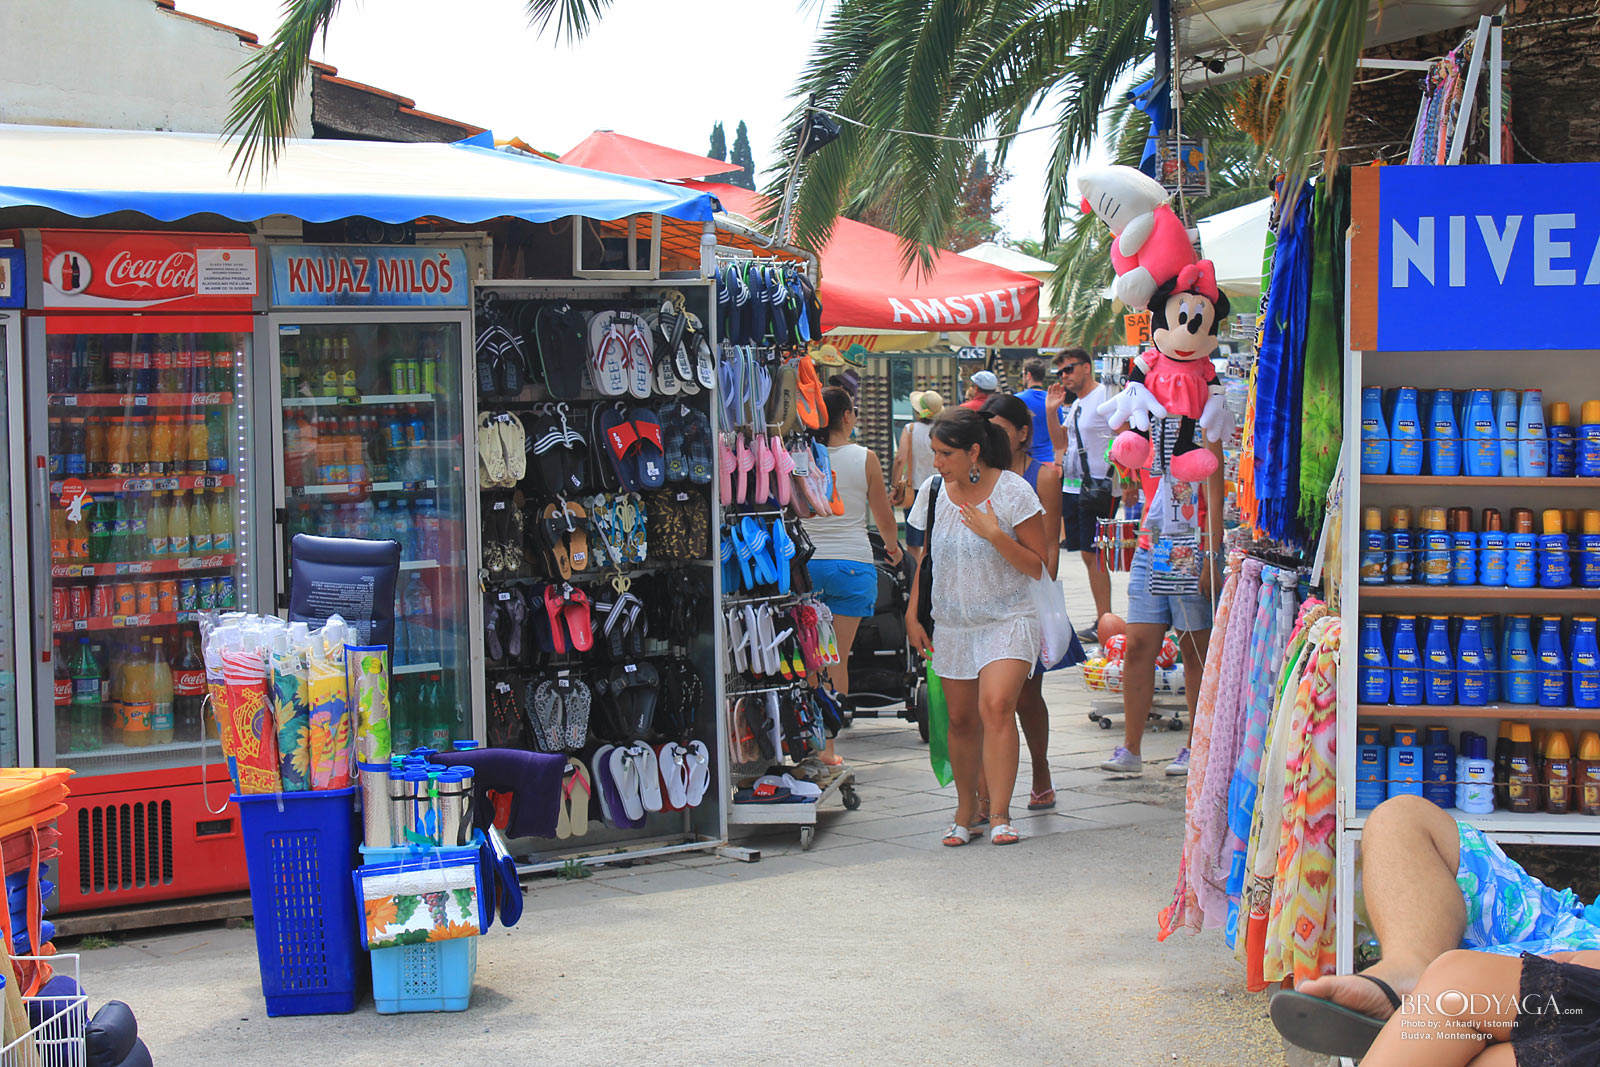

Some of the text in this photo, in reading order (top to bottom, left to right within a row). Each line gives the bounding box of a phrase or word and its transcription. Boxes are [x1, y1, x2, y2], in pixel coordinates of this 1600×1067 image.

[288, 253, 453, 294] KNJAZ MILOŠ
[887, 287, 1022, 324] AMSTEL
[958, 348, 986, 358] CK'S
[607, 358, 623, 391] REEF
[637, 360, 647, 392] REEF
[1171, 504, 1180, 522] I
